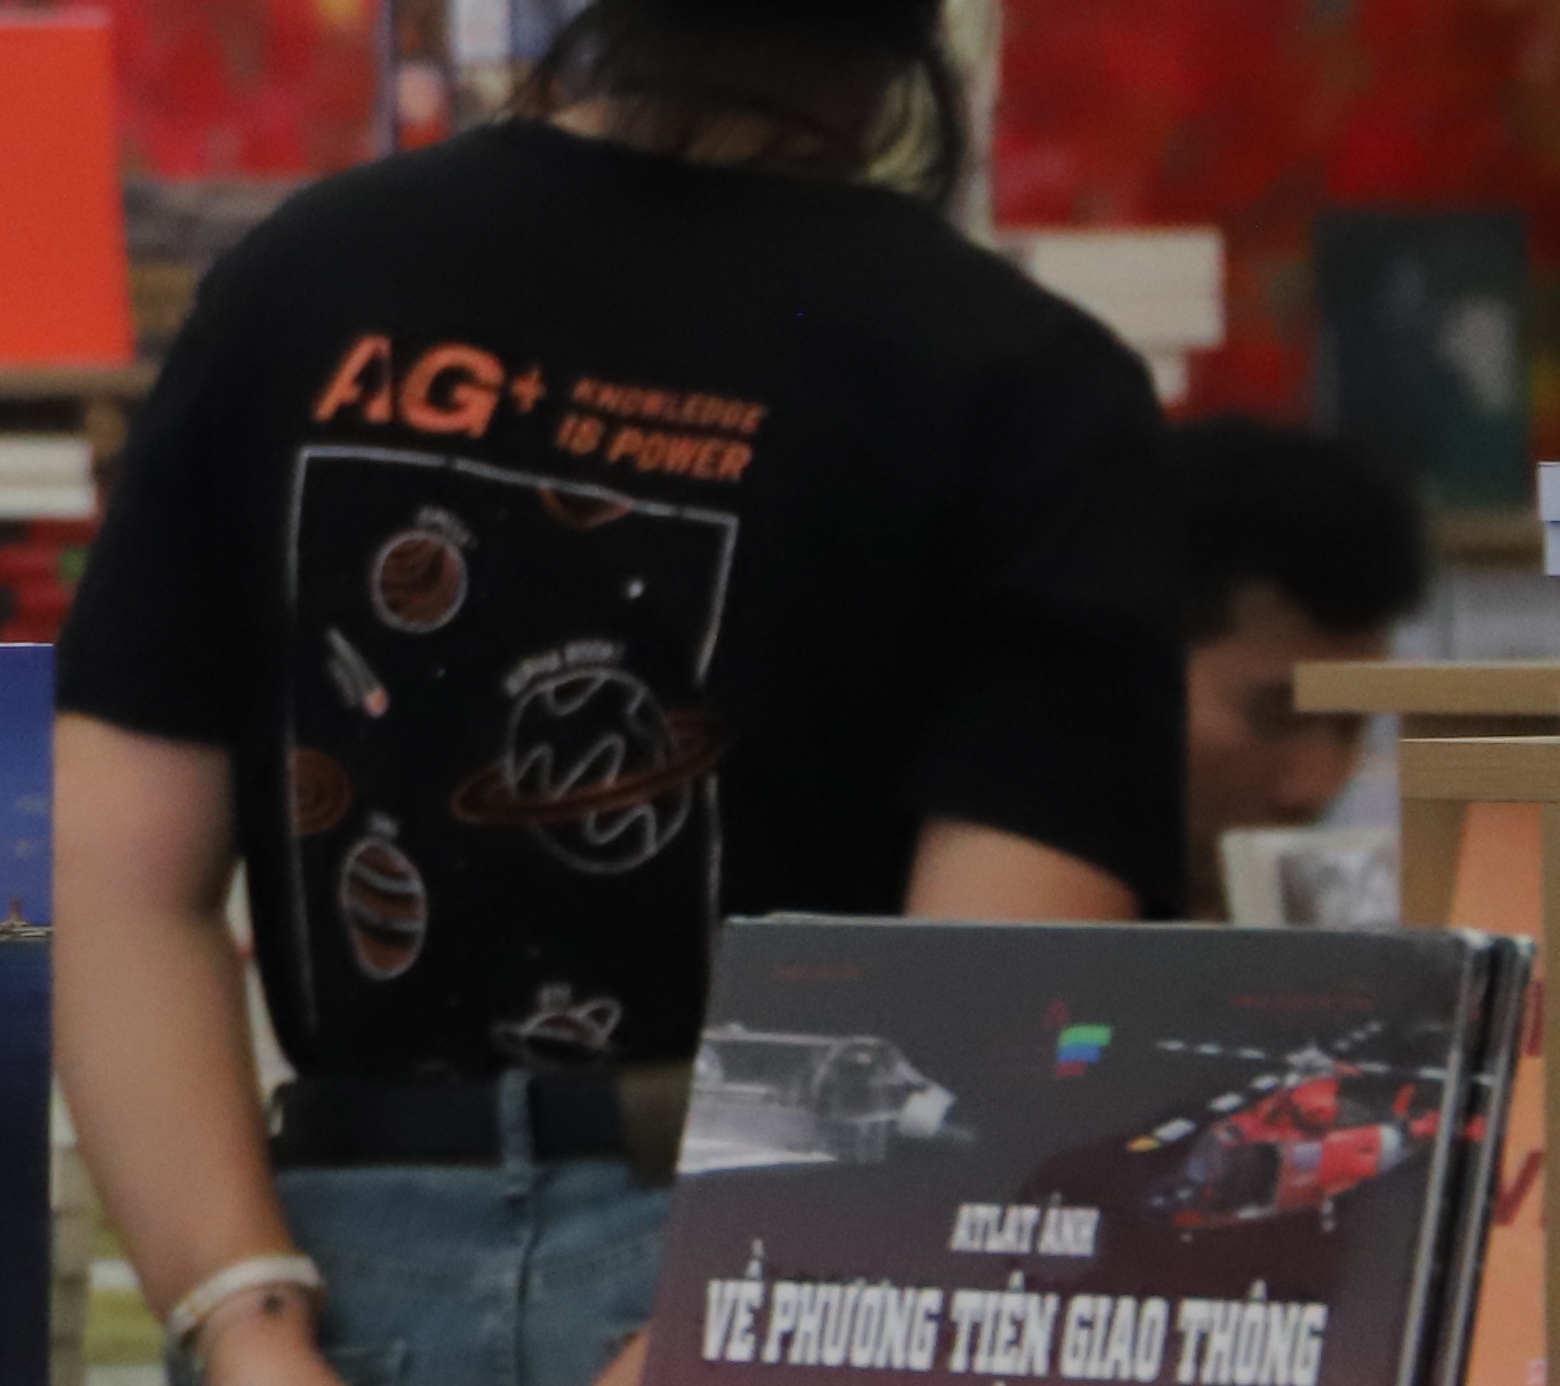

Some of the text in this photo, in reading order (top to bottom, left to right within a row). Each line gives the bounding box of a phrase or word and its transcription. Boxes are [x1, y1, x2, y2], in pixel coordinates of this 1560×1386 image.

[571, 378, 766, 431] KNOWLEDGE
[606, 425, 754, 482] POWER
[701, 1239, 767, 1363] VỀ
[765, 1276, 944, 1373] PHƯƠNG
[1058, 1298, 1168, 1381] GIAO
